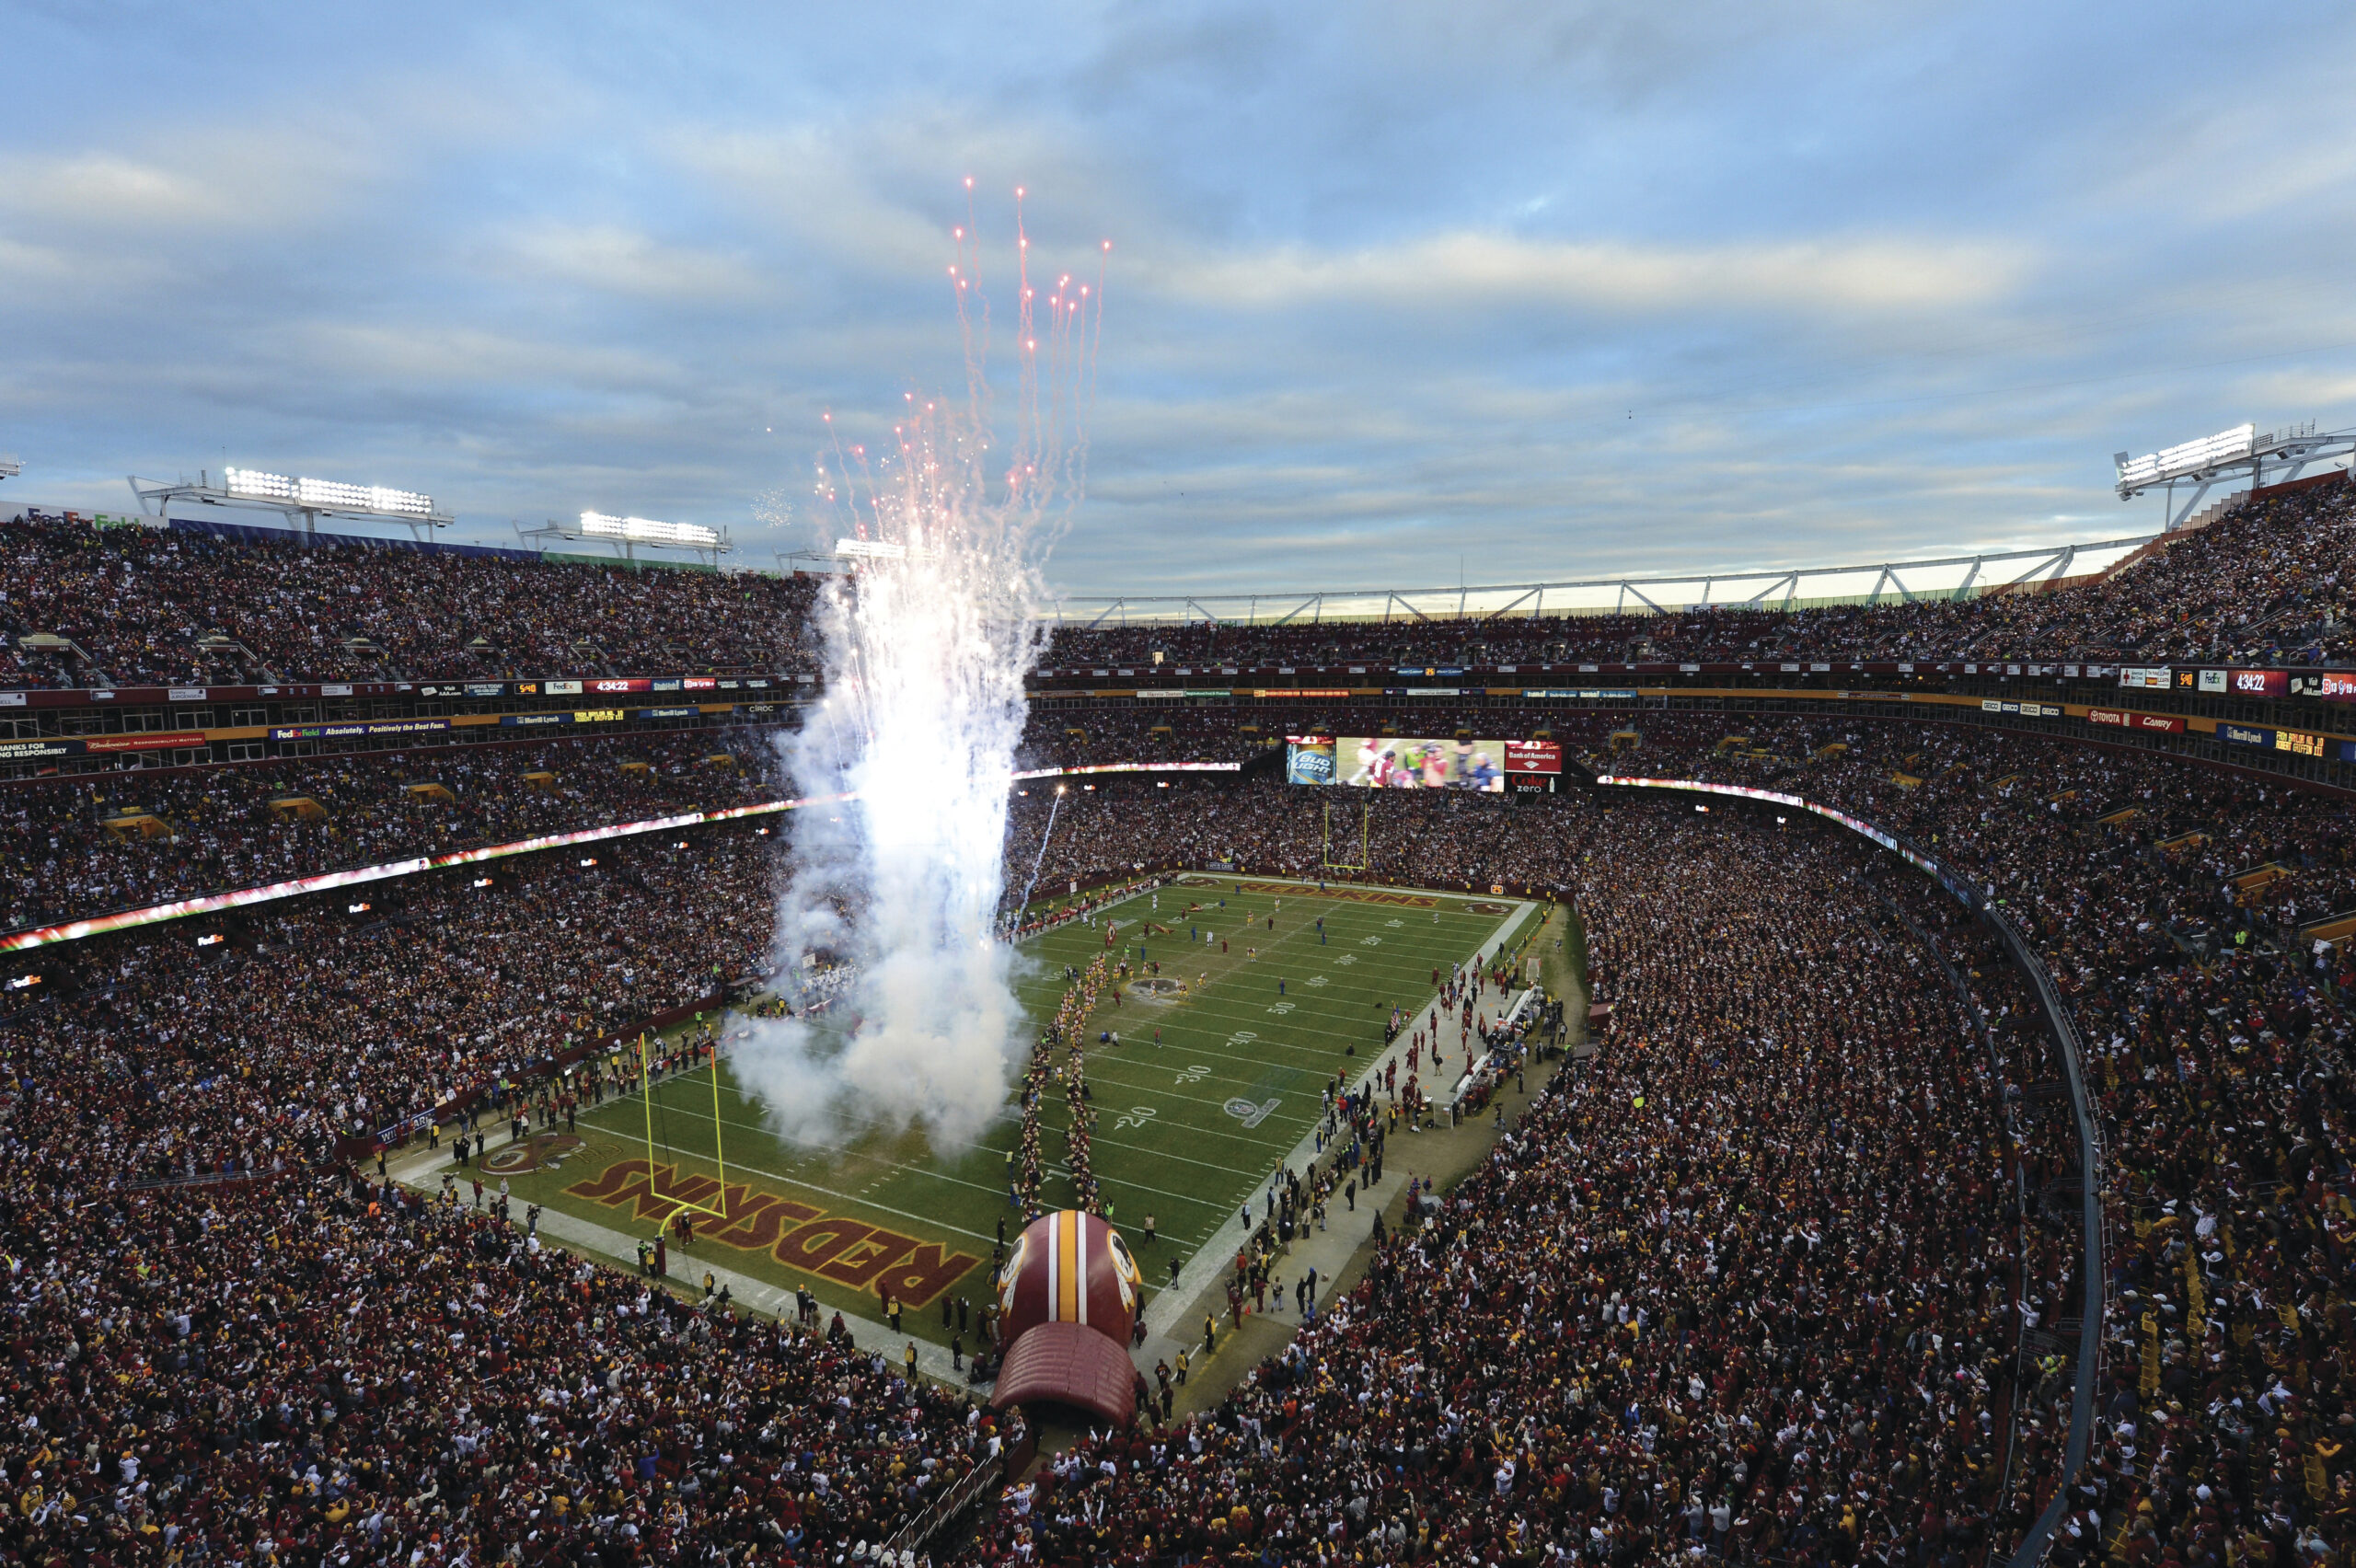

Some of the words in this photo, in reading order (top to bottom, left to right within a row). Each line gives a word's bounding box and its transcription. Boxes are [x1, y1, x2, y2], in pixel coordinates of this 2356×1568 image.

[2205, 673, 2221, 684] FedEx
[2236, 674, 2265, 691] 4:34:22
[519, 685, 537, 693] 5:40
[596, 682, 629, 691] 4:34:22
[543, 716, 560, 724] Lynch
[2098, 712, 2120, 723] TOYOTA
[2142, 717, 2173, 730] CAMRY
[325, 727, 364, 736] Absolutely,
[368, 724, 402, 734] Positively
[403, 723, 413, 732] the
[414, 722, 429, 731] Best
[2233, 729, 2247, 741] Merrill
[2248, 732, 2262, 744] Lynch
[14, 747, 67, 757] RESPONSIBLY
[1293, 762, 1331, 773] LIGHT
[1299, 755, 1331, 767] BUD
[1511, 773, 1547, 787] Coke
[1517, 785, 1542, 793] zero
[1240, 882, 1440, 908] REDSKINS
[197, 934, 225, 947] FedEx
[13, 974, 42, 988] edEx
[1265, 1002, 1296, 1015] 50
[1228, 1031, 1258, 1045] 40
[1176, 1065, 1212, 1083] 30
[1116, 1106, 1157, 1129] 20
[560, 1159, 985, 1311] REDSKINS
